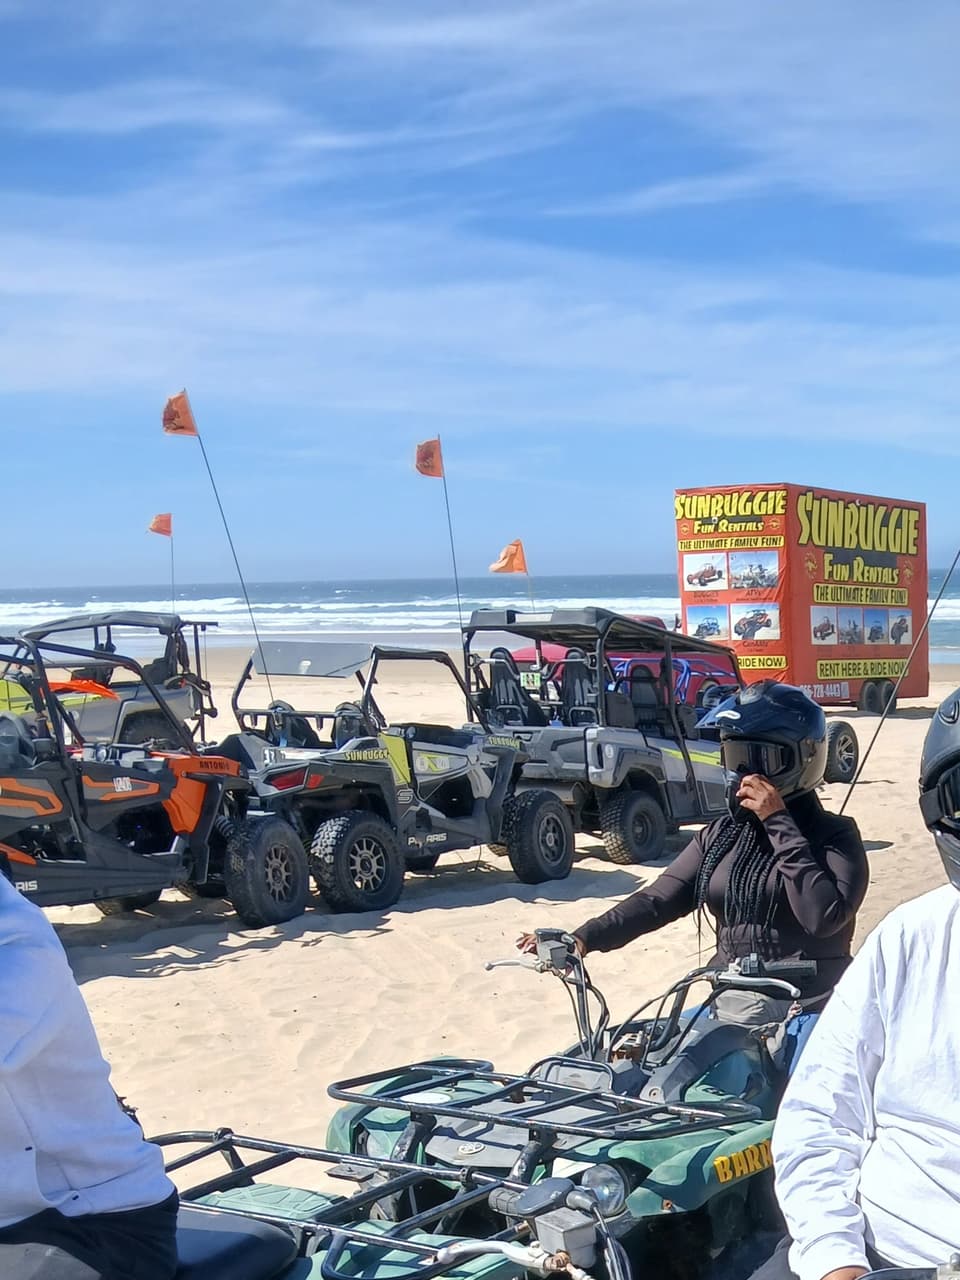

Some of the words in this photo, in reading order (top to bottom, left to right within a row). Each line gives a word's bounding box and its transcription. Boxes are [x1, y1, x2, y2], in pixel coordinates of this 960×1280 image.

[674, 490, 787, 520] SUNBUGGIE
[797, 491, 919, 554] SUNBUGGIE
[680, 541, 692, 550] THE
[694, 539, 727, 549] ULTIMATE
[730, 537, 758, 548] FAMILY
[816, 585, 828, 601] THE
[831, 586, 863, 602] ULTIMATE
[865, 588, 889, 604] FAMILY
[737, 658, 757, 667] RIDE
[758, 657, 783, 667] NOW
[820, 664, 840, 677] RENT
[842, 663, 861, 676] HERE
[862, 663, 869, 676] &
[870, 662, 887, 676] RIDE
[408, 833, 447, 847] PARIS
